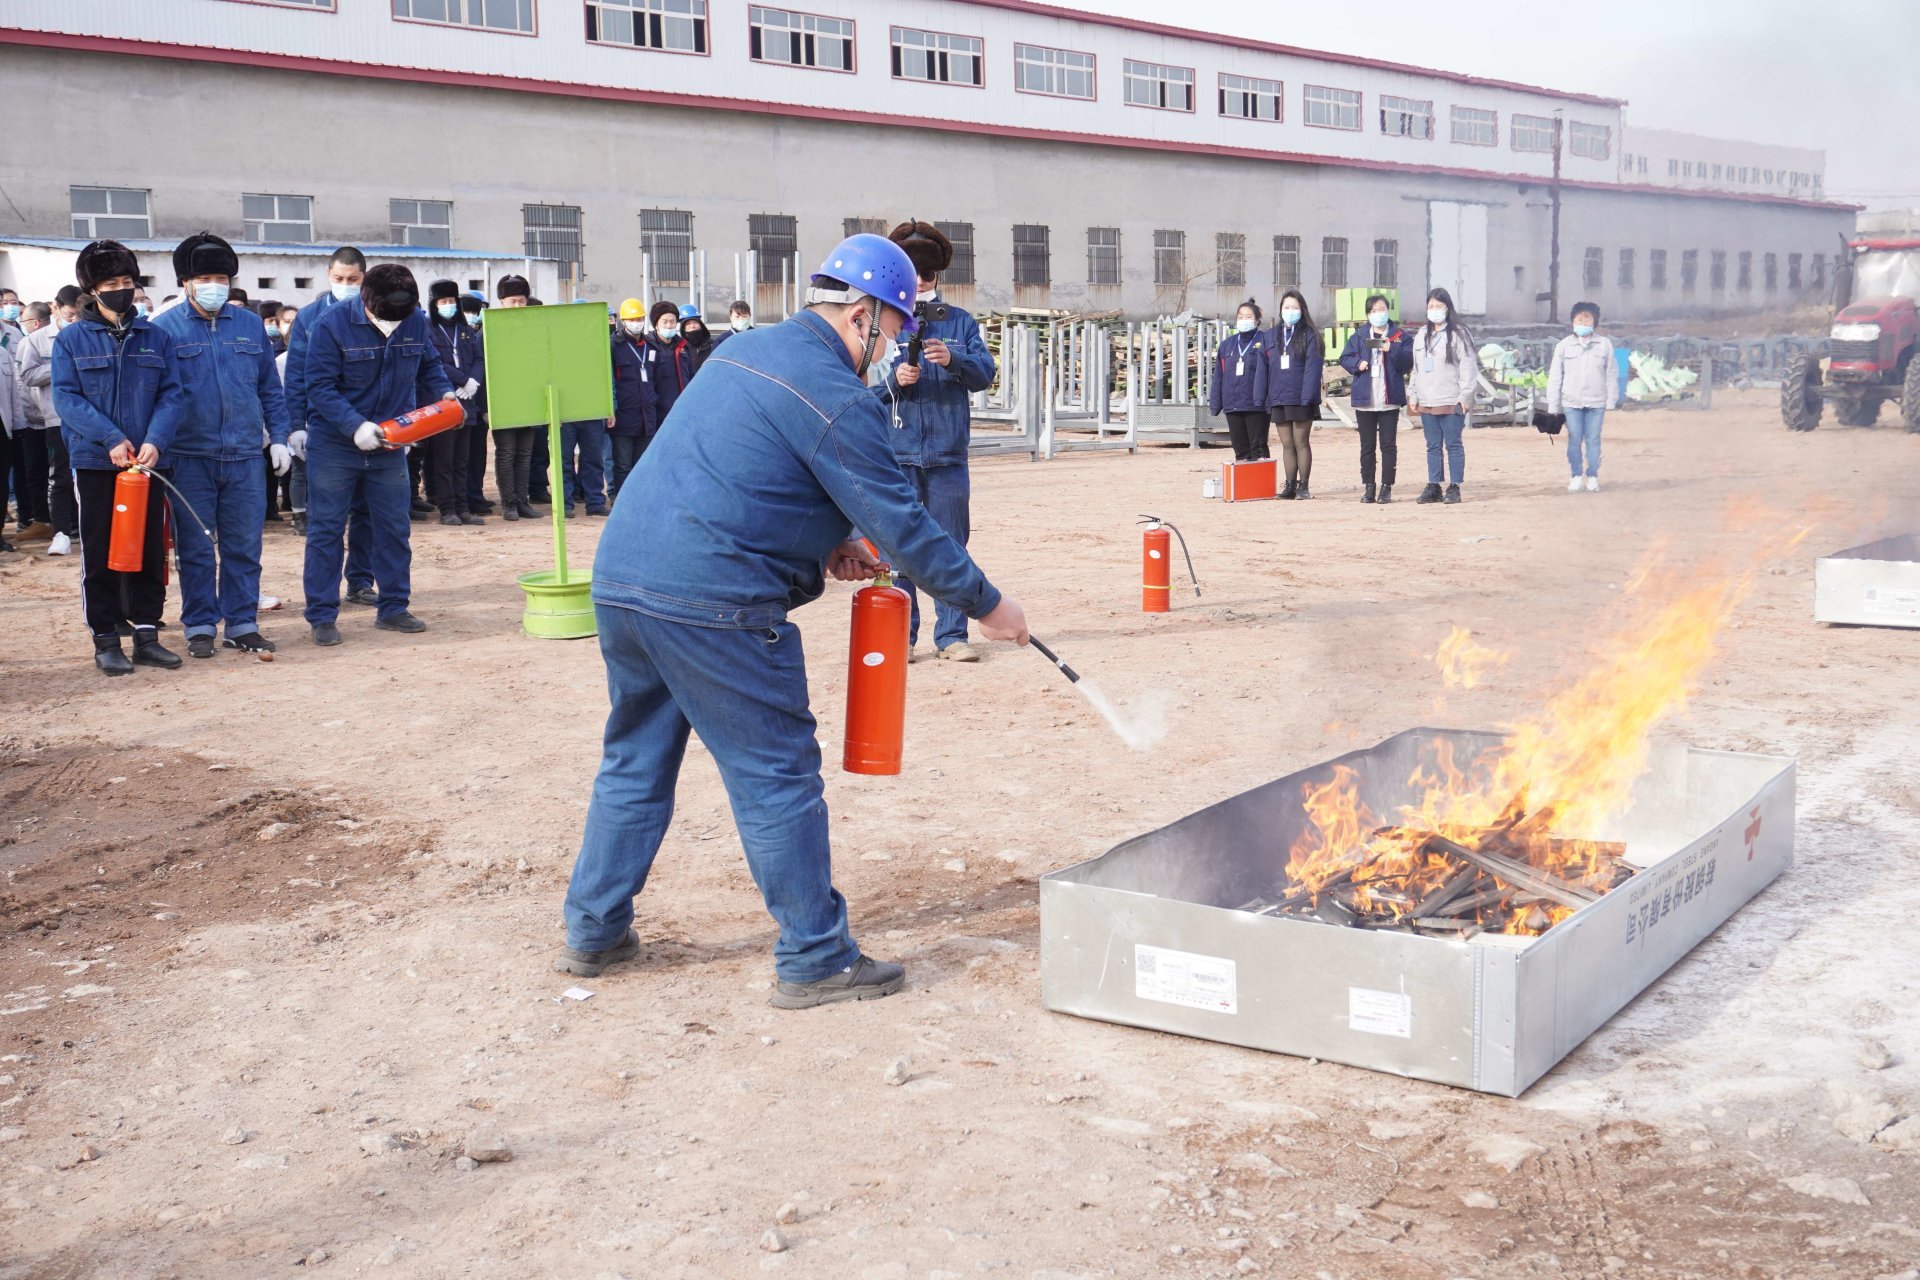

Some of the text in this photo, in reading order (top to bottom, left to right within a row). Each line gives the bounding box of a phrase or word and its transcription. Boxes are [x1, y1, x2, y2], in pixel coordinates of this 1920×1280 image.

[1627, 857, 1716, 943] 鞍钢股份有限公司
